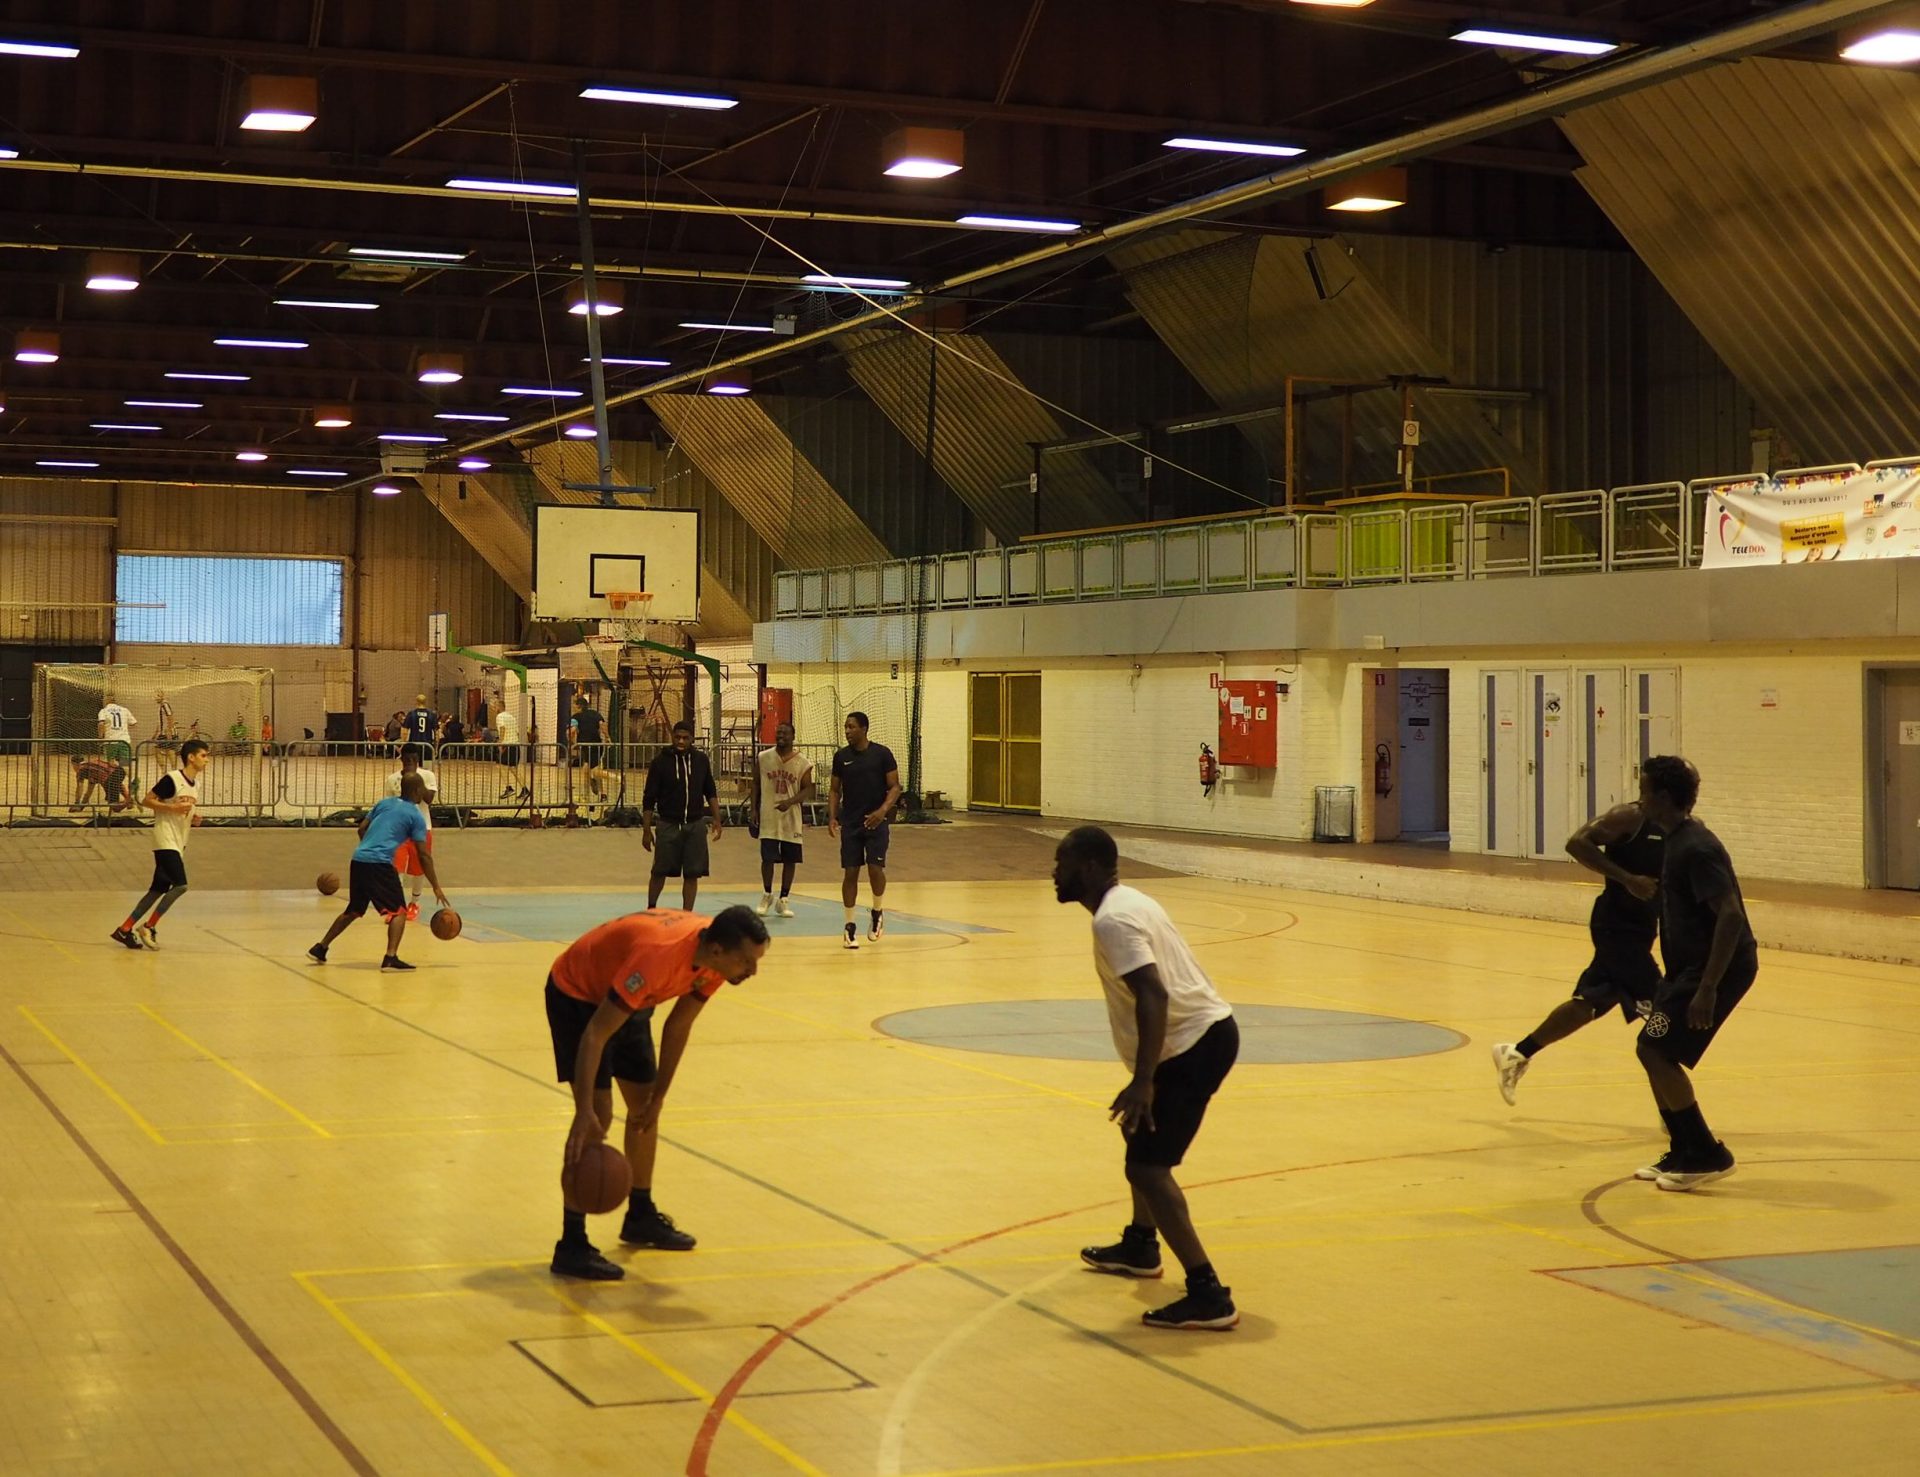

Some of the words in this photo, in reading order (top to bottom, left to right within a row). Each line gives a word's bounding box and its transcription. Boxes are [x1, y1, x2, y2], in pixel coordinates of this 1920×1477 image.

[1890, 501, 1912, 510] Rotary
[110, 711, 122, 728] 11
[418, 716, 426, 733] 9
